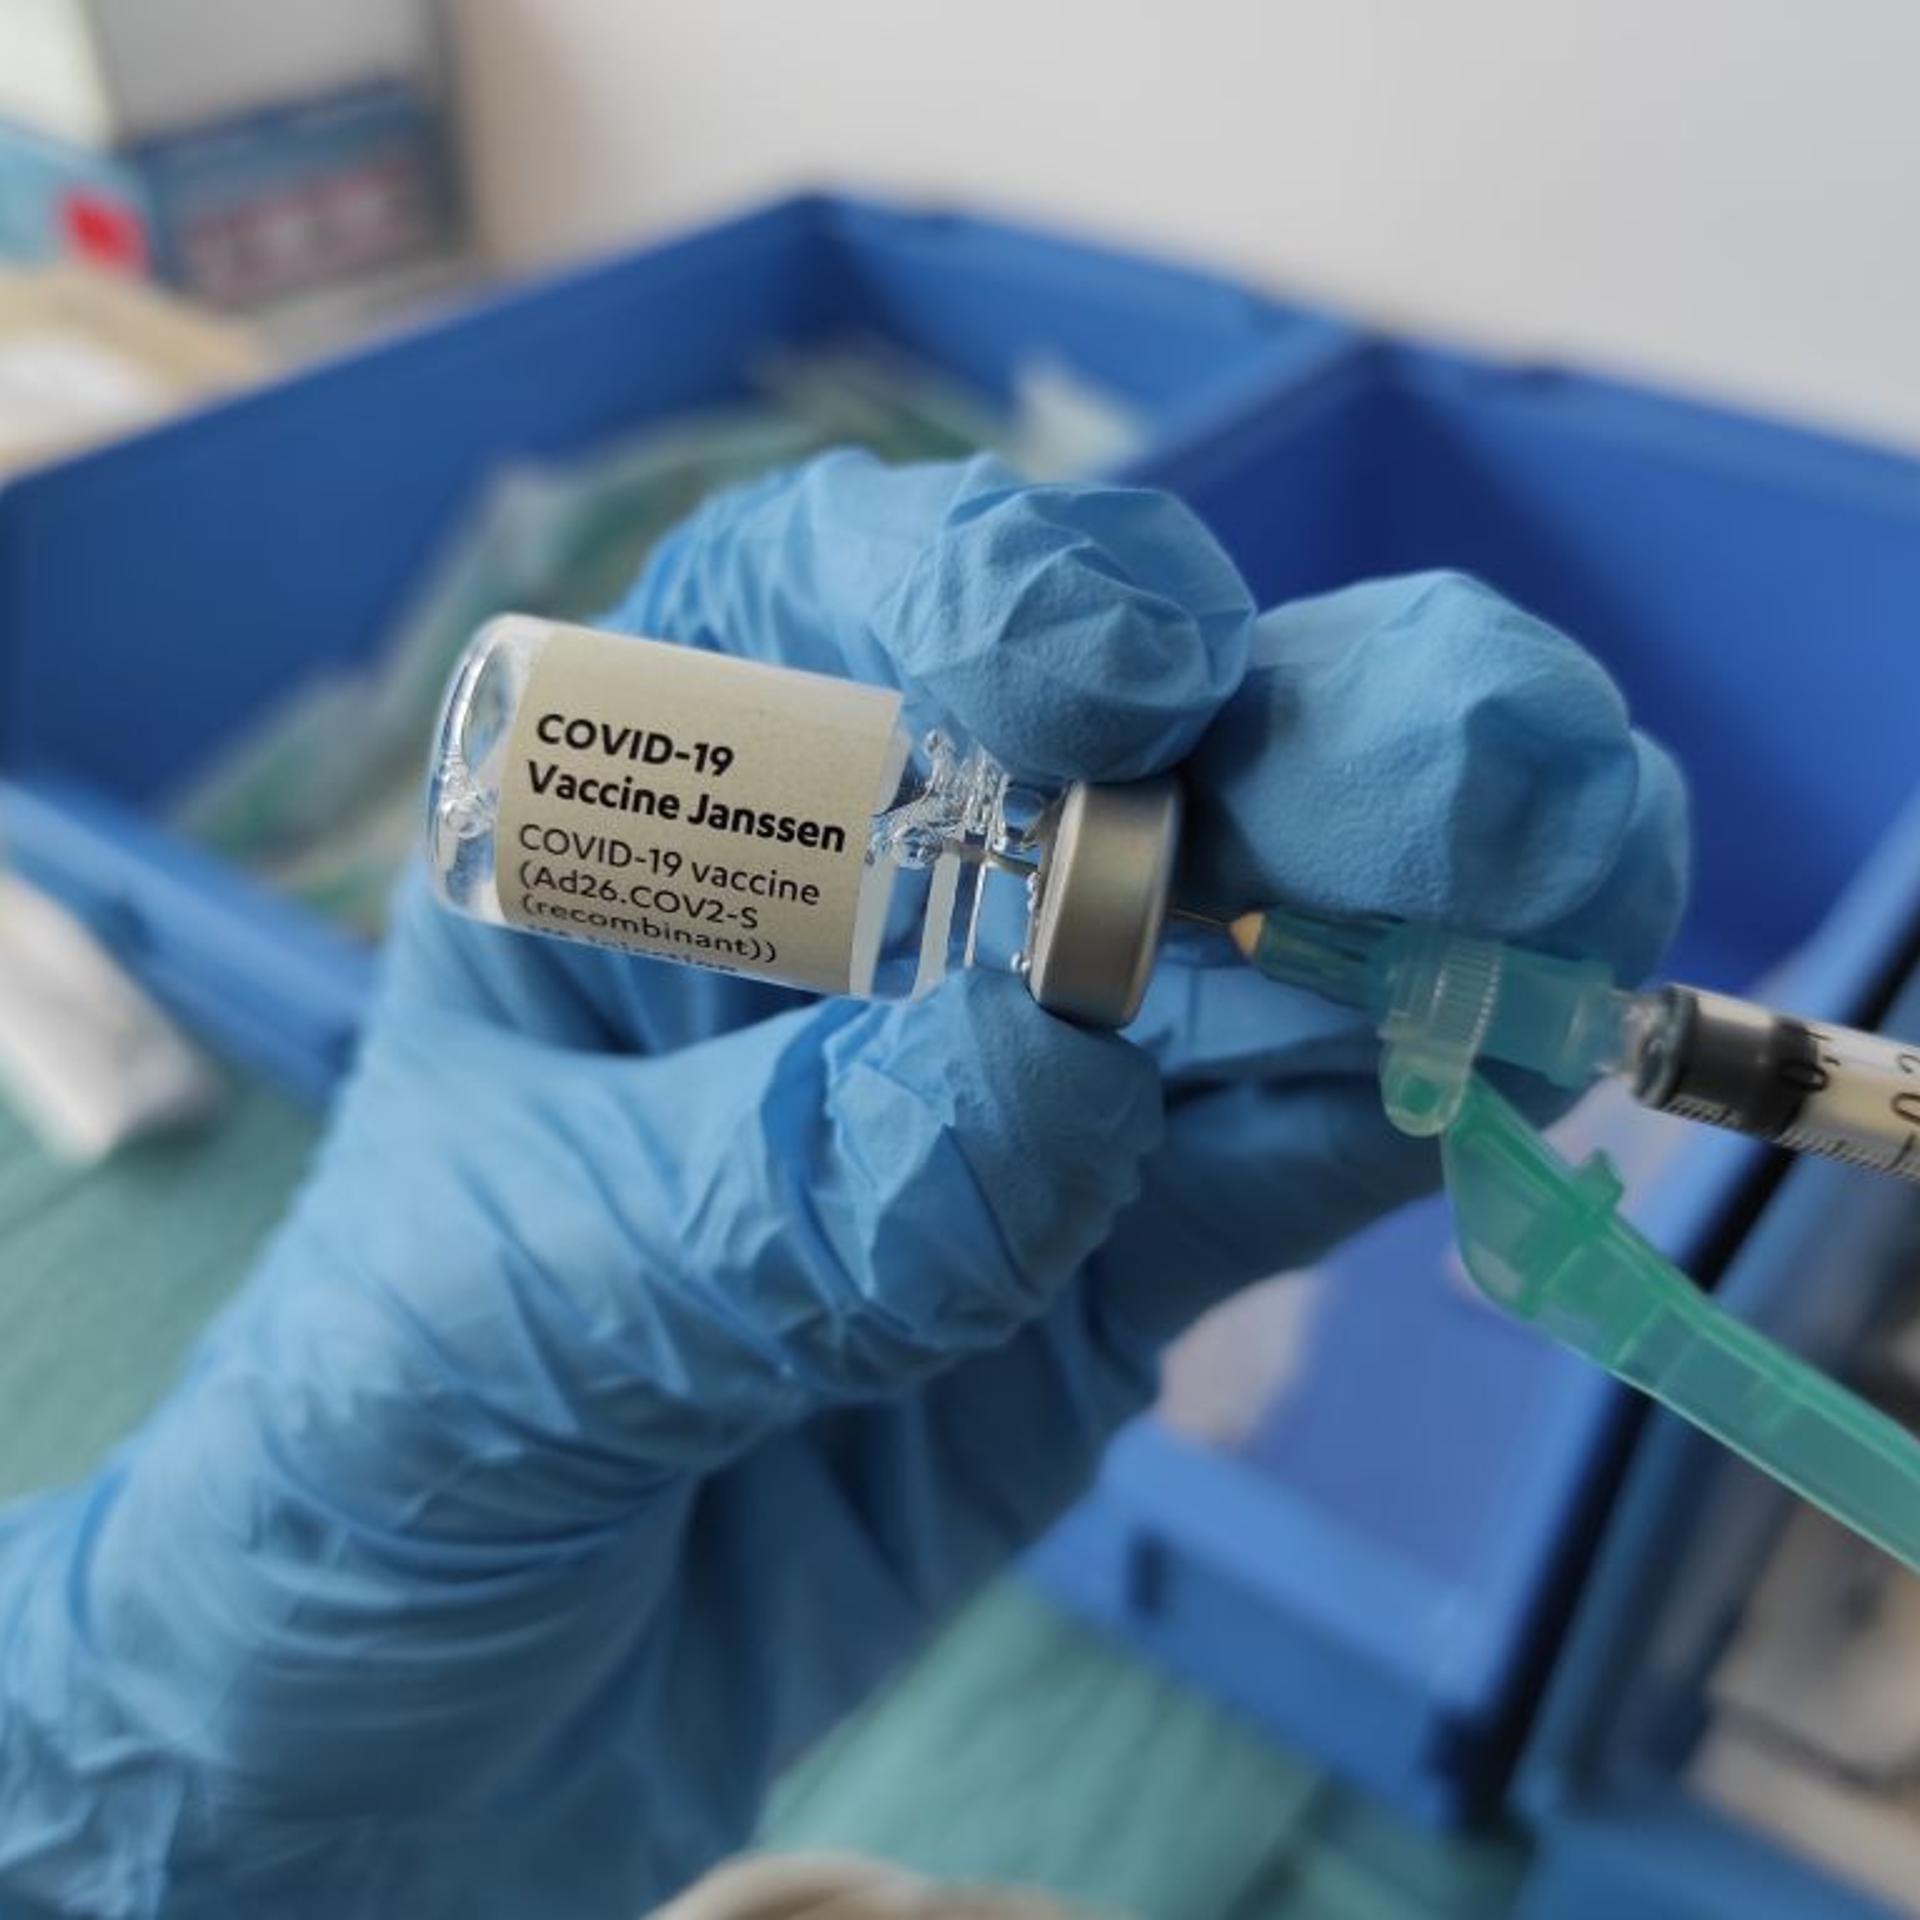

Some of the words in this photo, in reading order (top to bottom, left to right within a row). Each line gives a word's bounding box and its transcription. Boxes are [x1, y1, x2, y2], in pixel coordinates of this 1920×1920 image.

[536, 713, 735, 777] COVID-19
[528, 760, 681, 820] Vaccine
[686, 793, 847, 854] Janssen
[519, 823, 683, 877] COVID-19
[691, 861, 820, 907] vaccine
[519, 860, 759, 930] (Ad26.COV2-S
[522, 893, 777, 963] (recombinant))
